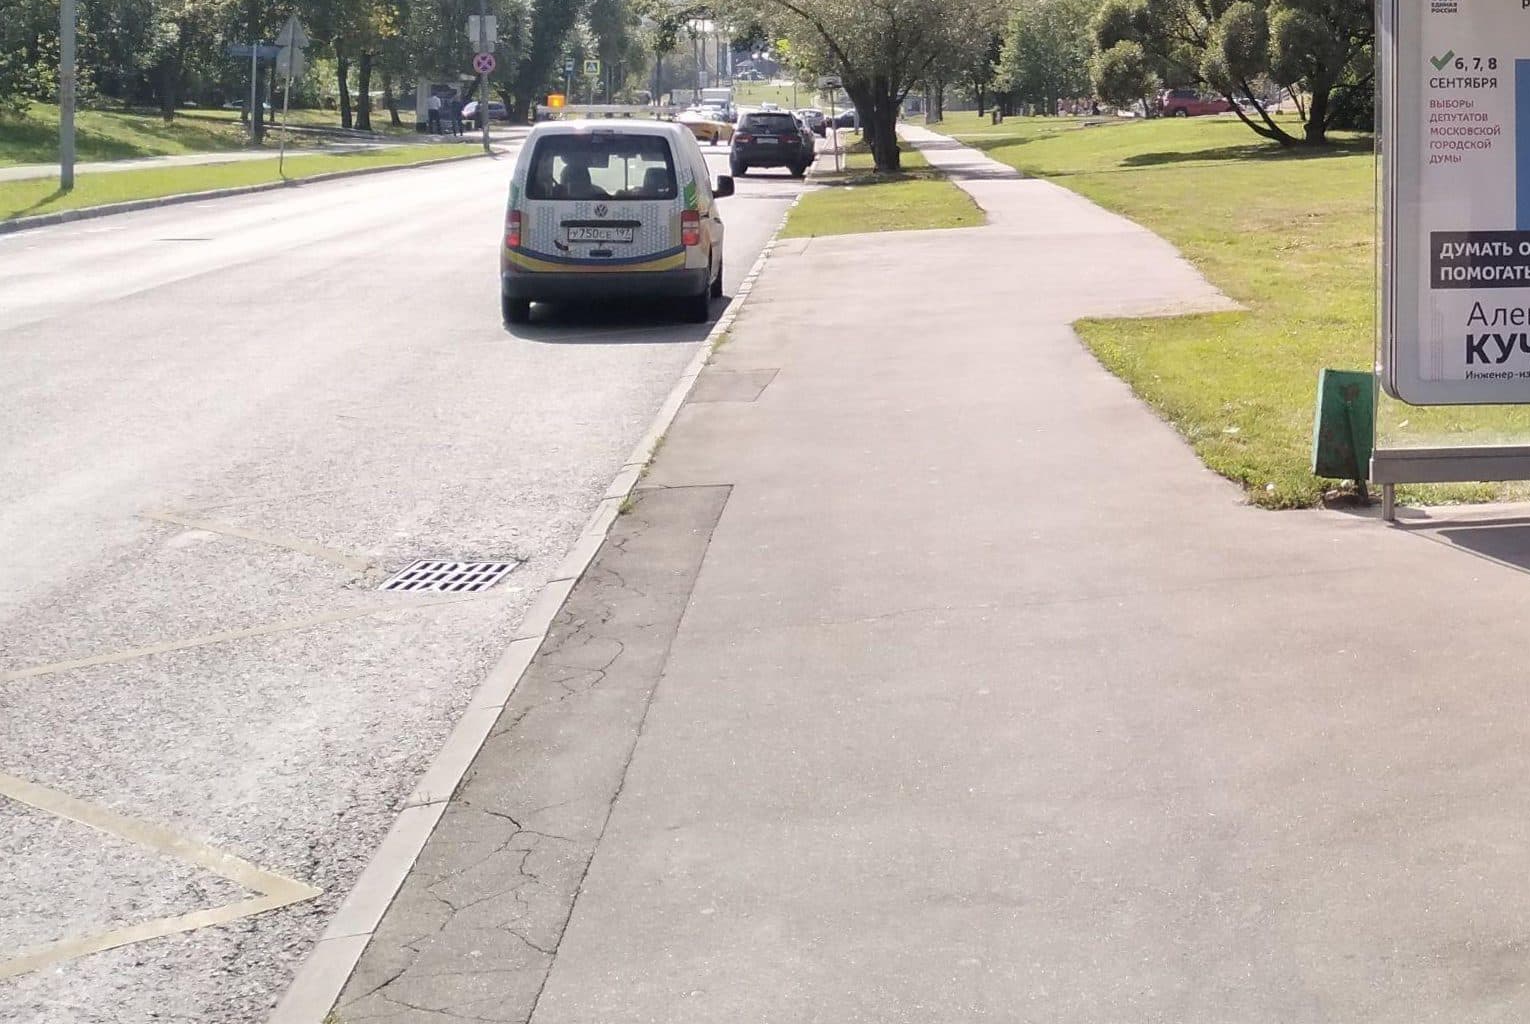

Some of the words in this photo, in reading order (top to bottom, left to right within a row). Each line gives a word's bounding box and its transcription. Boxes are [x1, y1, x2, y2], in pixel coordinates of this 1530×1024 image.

[1454, 57, 1468, 72] 6,
[1473, 57, 1484, 72] 7,
[1488, 57, 1498, 70] 8
[1429, 77, 1498, 89] СЕНТЯБРЯ
[1429, 99, 1474, 109] ВЫБОРЫ
[1429, 113, 1489, 123] ДЕПУТАТОВ
[1429, 125, 1501, 136] МОСКОВСКОЙ
[1429, 139, 1492, 150] ГОРОДСКОЙ
[1429, 154, 1462, 164] ДУМЫ
[1439, 242, 1513, 259] ДУМАТЬ
